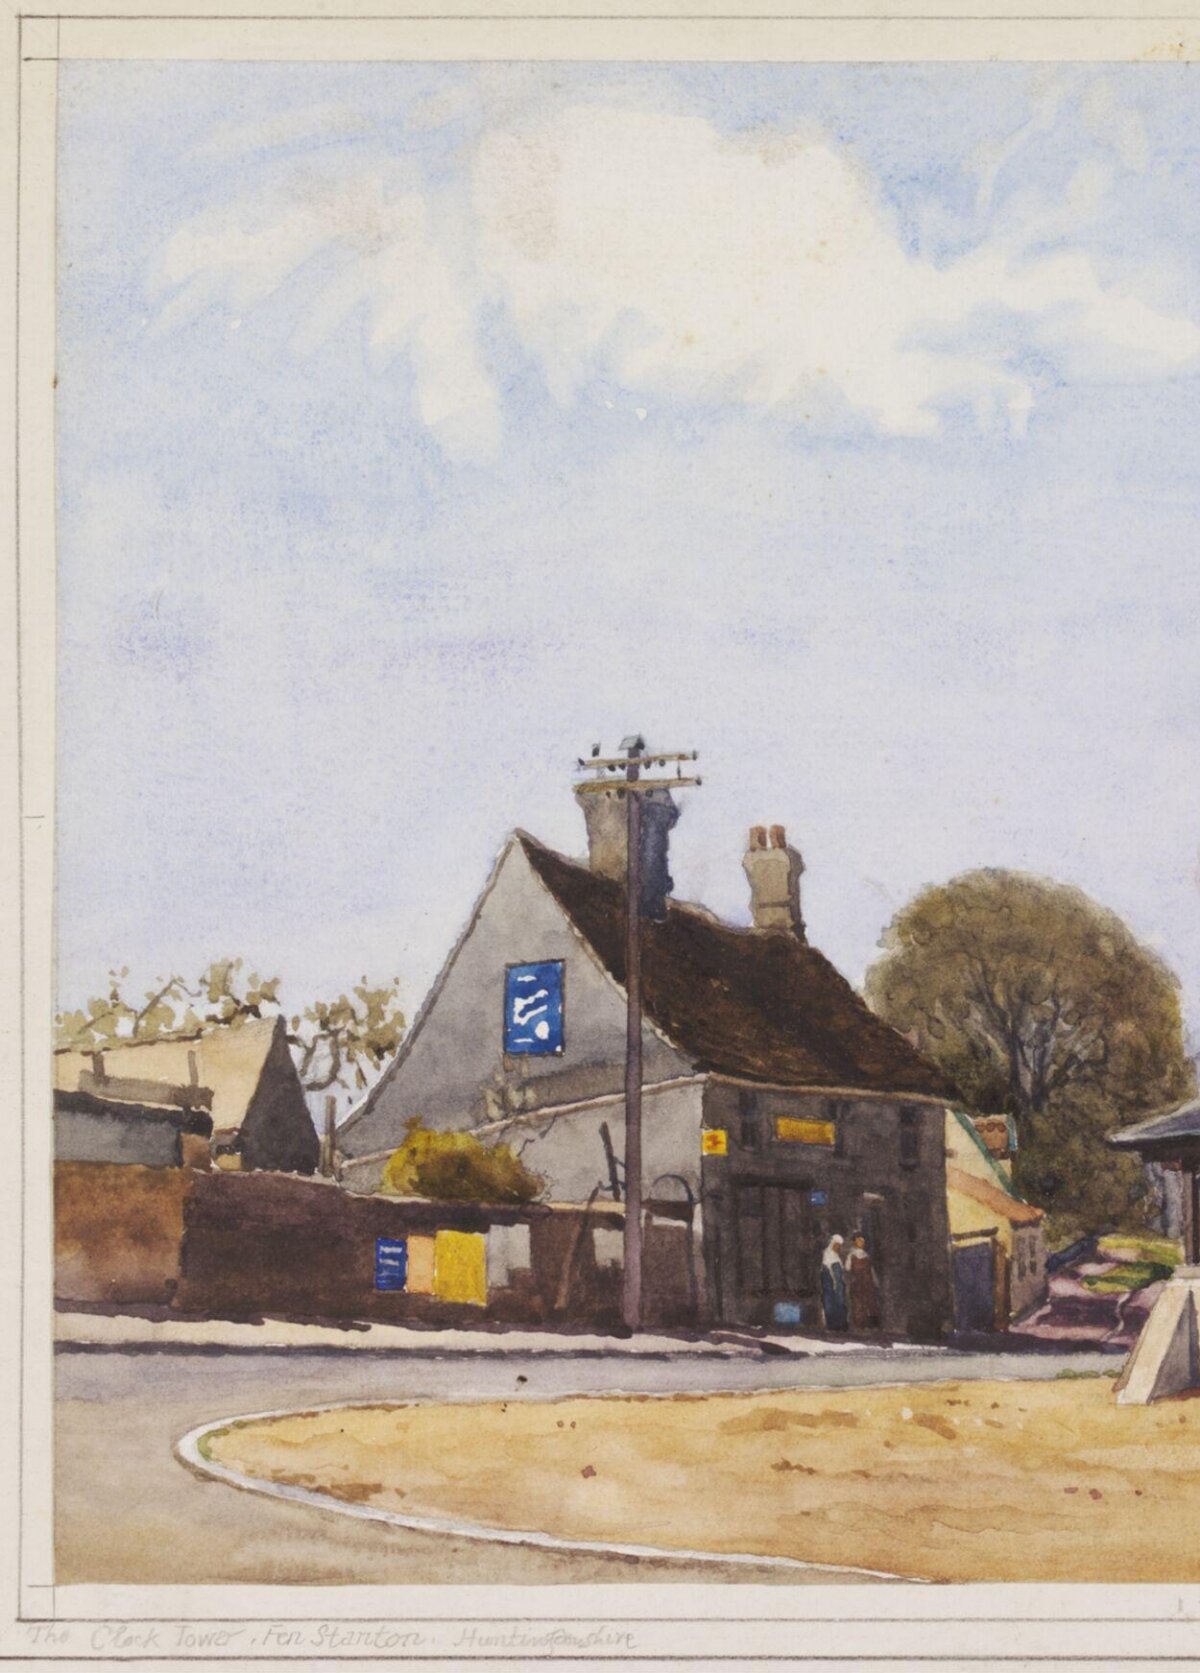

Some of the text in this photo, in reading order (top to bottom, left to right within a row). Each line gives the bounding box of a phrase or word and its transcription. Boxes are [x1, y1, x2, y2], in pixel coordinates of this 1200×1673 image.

[27, 1625, 70, 1646] The
[91, 1625, 161, 1650] Clock
[262, 1624, 305, 1647] Fen
